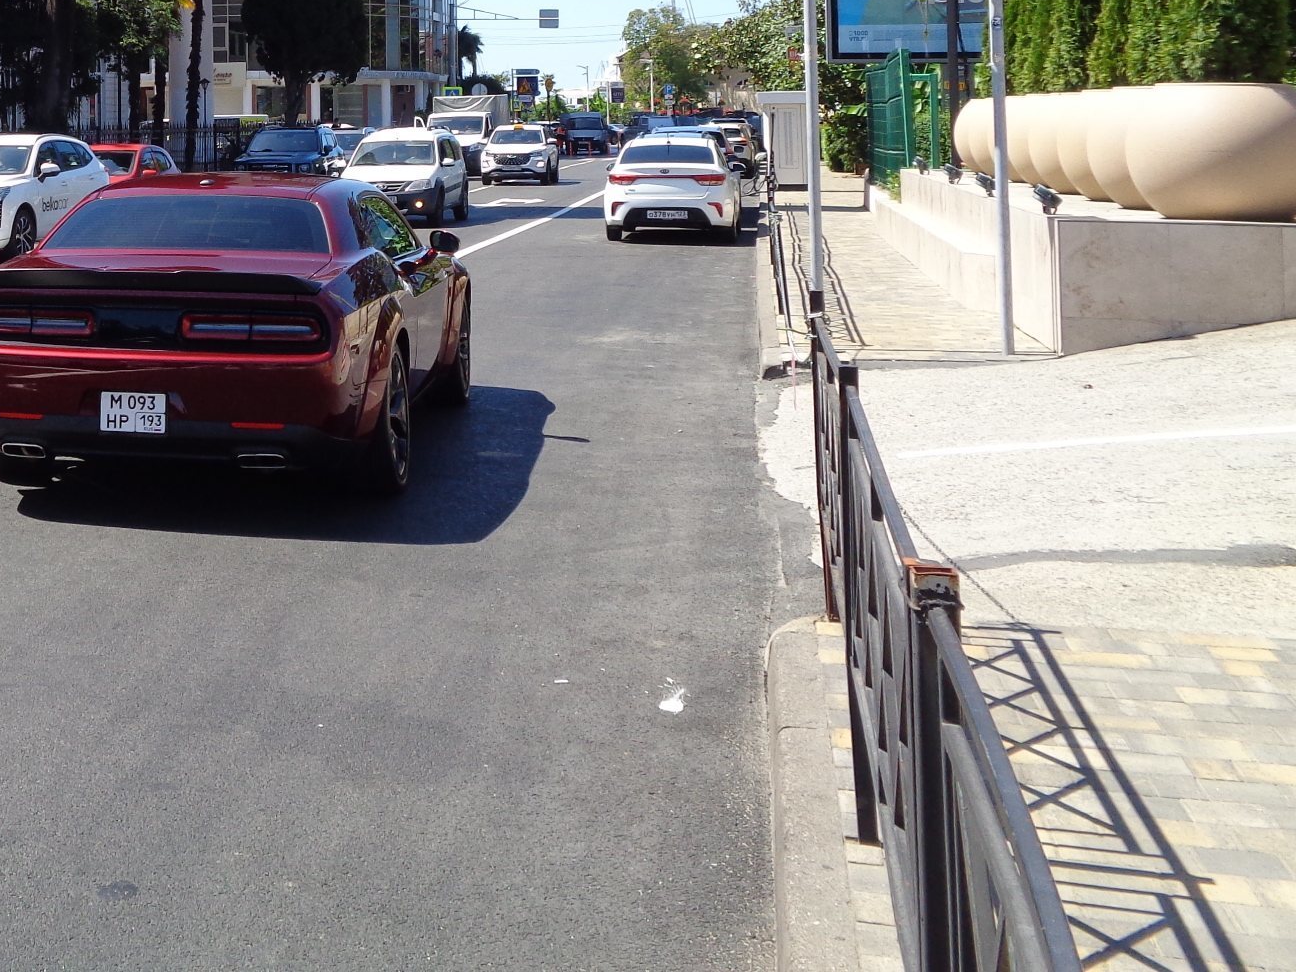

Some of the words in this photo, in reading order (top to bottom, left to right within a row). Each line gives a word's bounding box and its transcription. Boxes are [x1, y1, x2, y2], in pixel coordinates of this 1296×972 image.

[128, 395, 156, 411] 093
[106, 413, 129, 429] НР
[139, 414, 162, 427] 193
